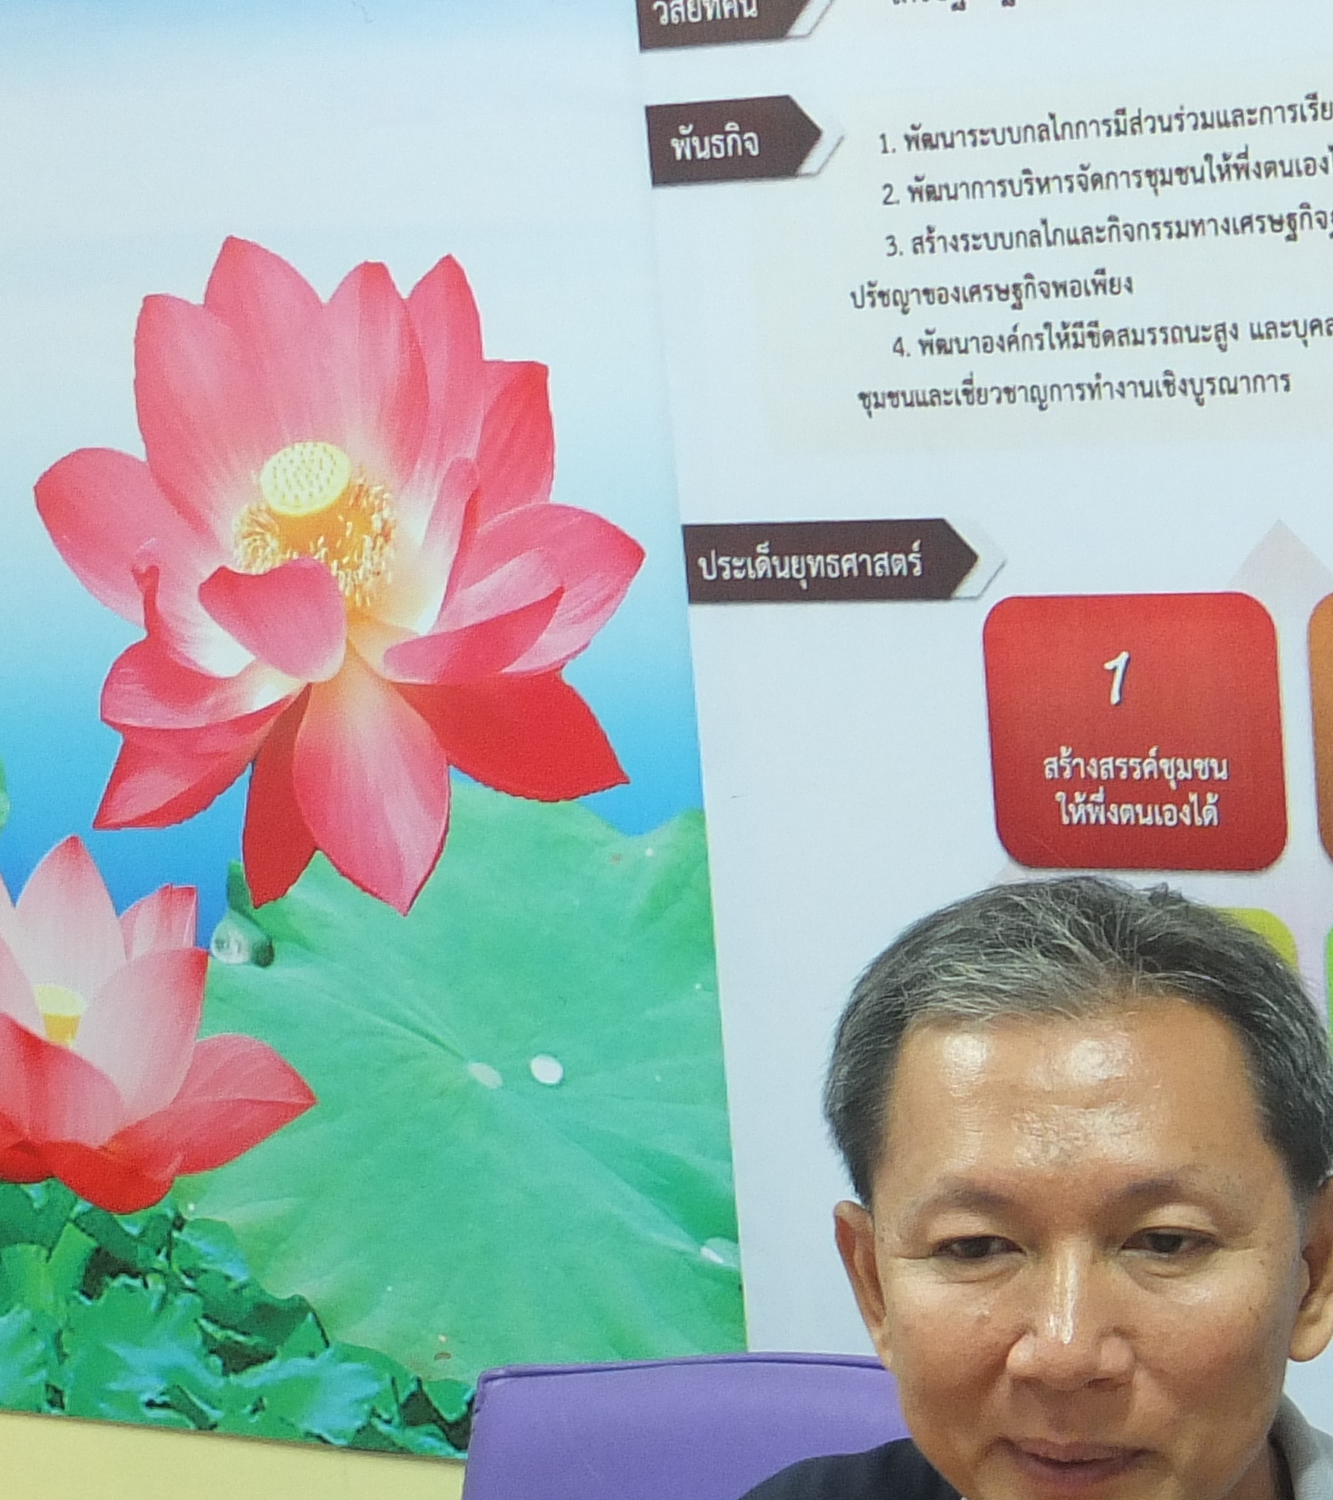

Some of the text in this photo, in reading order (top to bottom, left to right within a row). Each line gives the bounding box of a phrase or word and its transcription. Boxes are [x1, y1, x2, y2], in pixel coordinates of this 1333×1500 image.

[670, 122, 760, 161] พันธกิจ
[850, 268, 1134, 315] ปรัชญาของเศรษฐกิจพอเพียง
[857, 367, 1292, 419] ชุมชนและเชี่ยวชาญการทำงานเชิงบูรณาการ
[698, 540, 922, 590] ประเด็นยุทธศาสตร์
[1104, 651, 1130, 706] 1
[1043, 745, 1230, 789] สร้างสรรค์ชุมชน
